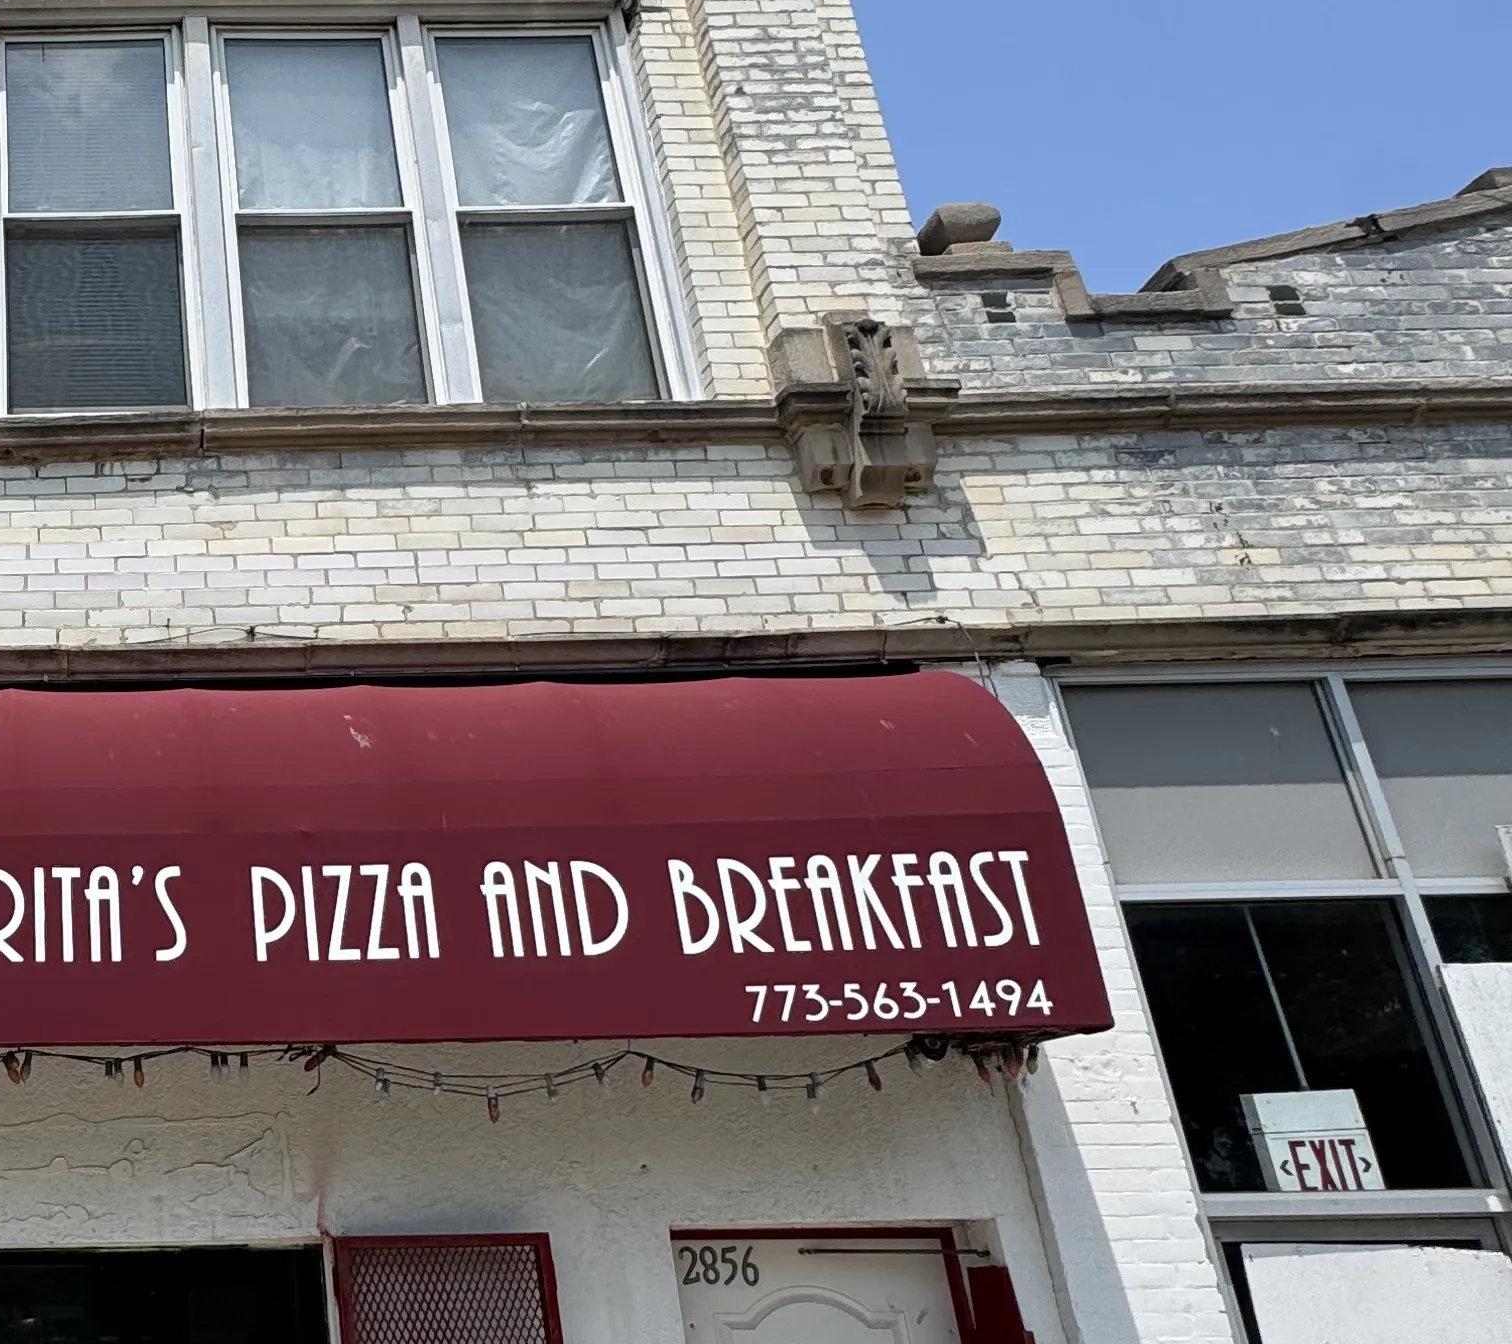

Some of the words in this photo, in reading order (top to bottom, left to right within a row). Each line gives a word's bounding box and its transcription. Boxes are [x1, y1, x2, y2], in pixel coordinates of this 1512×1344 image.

[250, 862, 441, 962] PIZZA
[479, 859, 630, 959] AND
[666, 849, 1041, 956] BREAKFAST
[744, 978, 1055, 1024] 773-563-1494
[1287, 1138, 1365, 1192] EXIT
[678, 1245, 760, 1287] 2856
